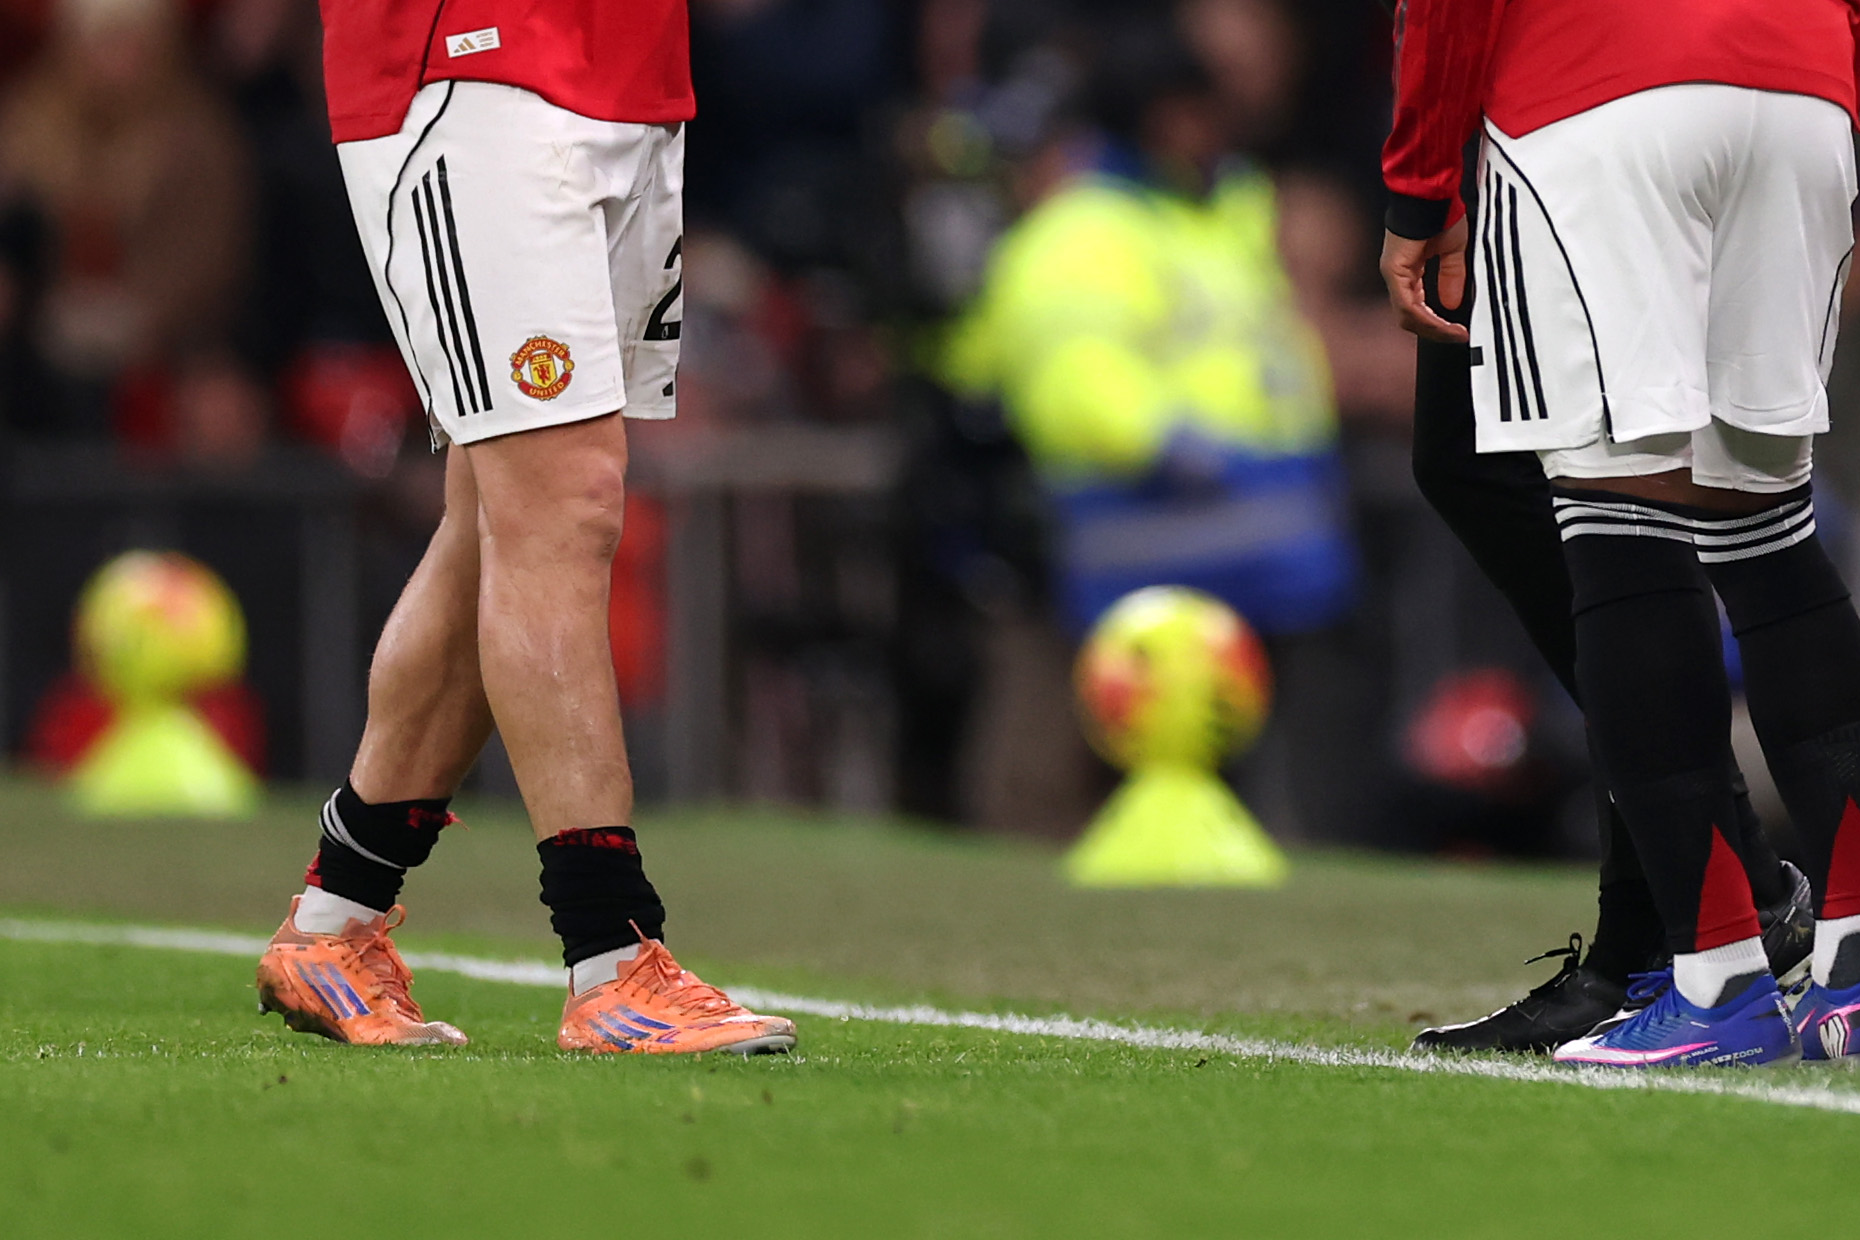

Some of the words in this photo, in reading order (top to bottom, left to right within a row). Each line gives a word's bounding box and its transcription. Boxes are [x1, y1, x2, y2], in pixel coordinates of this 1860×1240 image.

[643, 234, 682, 341] 2
[514, 340, 565, 366] MANCHESTER
[529, 381, 565, 397] UNITED
